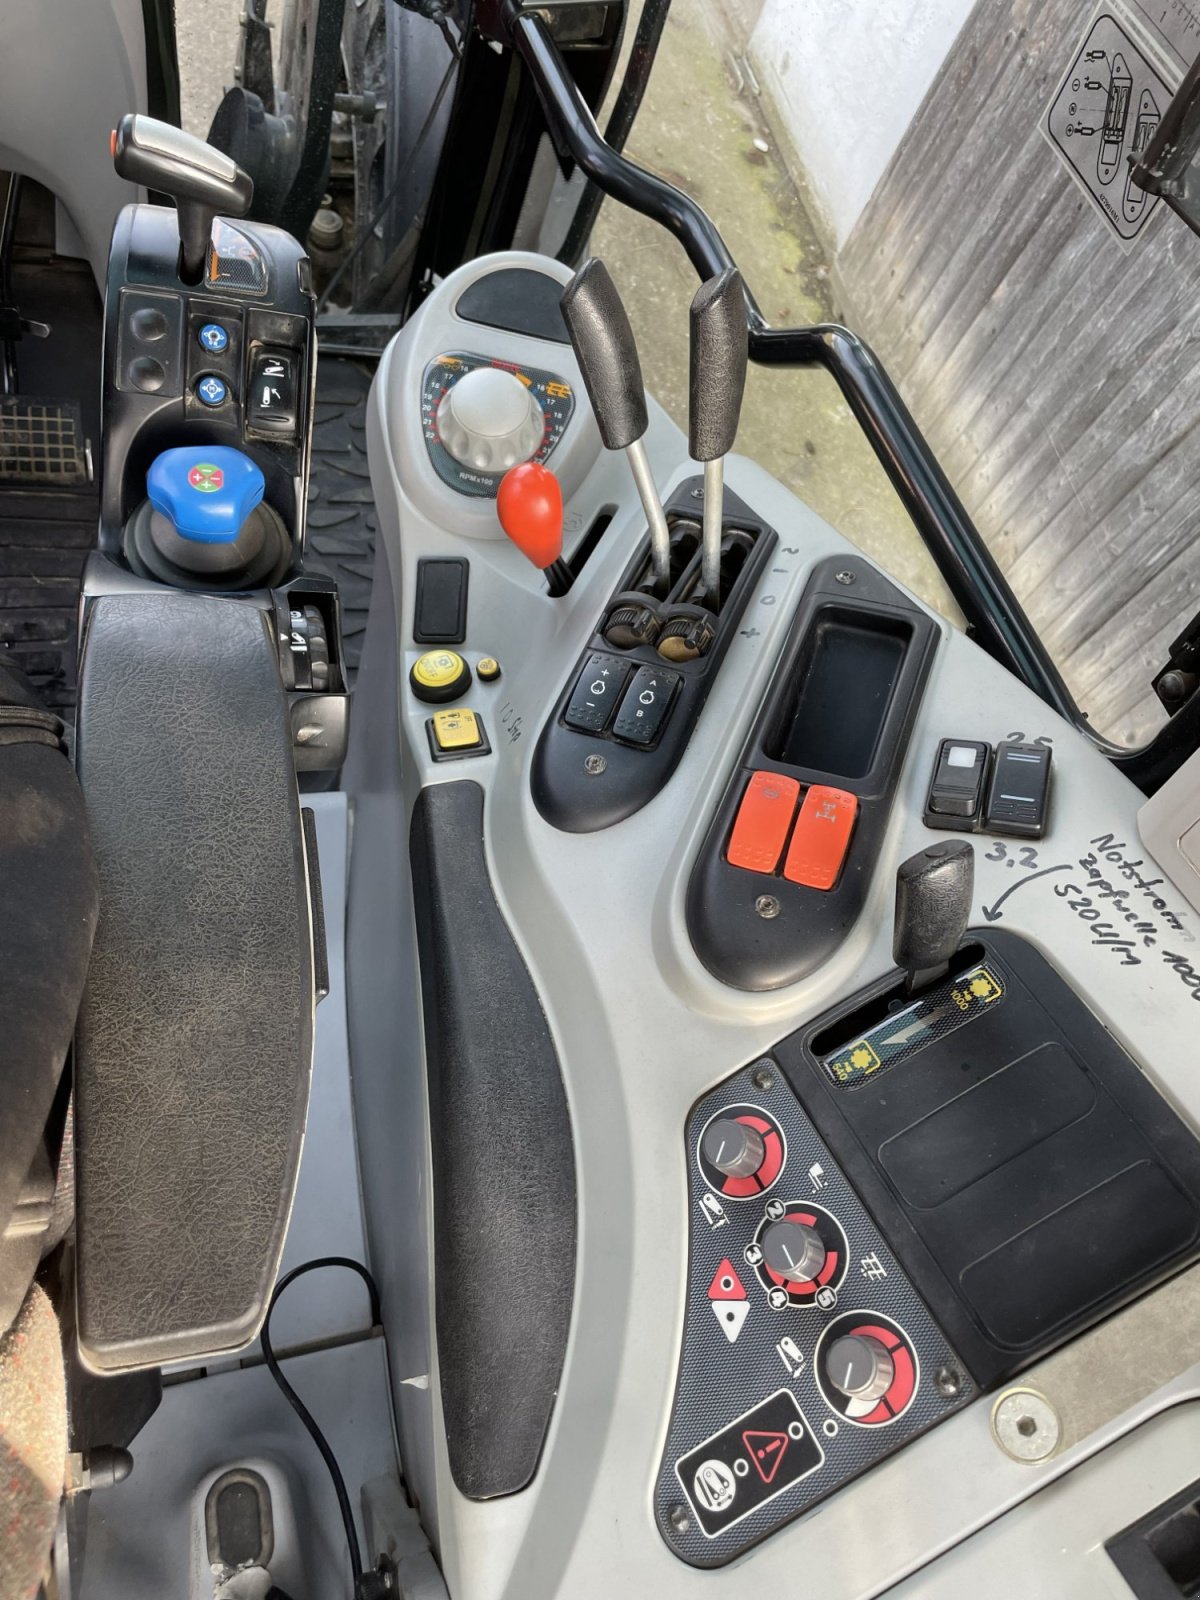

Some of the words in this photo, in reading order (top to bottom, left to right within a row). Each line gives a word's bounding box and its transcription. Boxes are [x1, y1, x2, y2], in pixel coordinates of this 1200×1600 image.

[425, 431, 435, 439] 22
[649, 679, 657, 687] A
[636, 709, 644, 718] B
[951, 989, 969, 1011] 1000
[832, 1062, 848, 1081] 540
[767, 1202, 783, 1219] 2
[746, 1246, 762, 1263] 3
[771, 1290, 787, 1307] 4
[817, 1289, 835, 1308] 5
